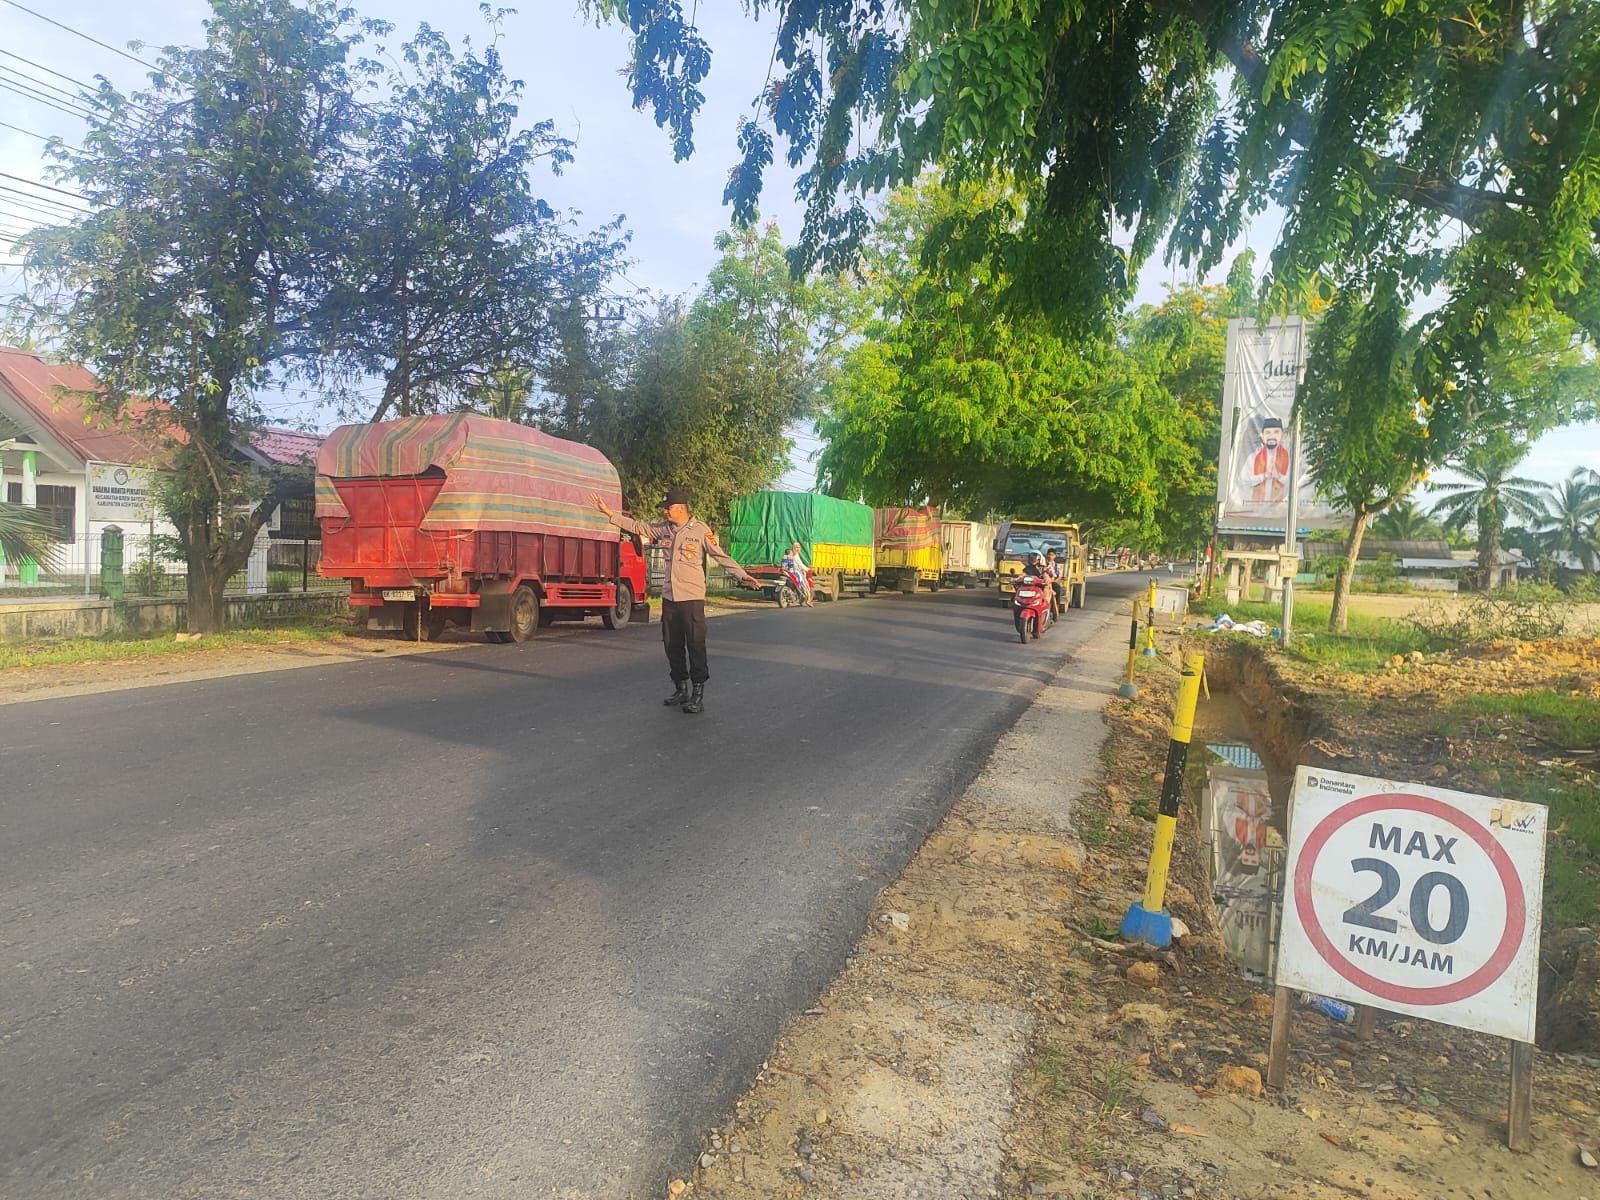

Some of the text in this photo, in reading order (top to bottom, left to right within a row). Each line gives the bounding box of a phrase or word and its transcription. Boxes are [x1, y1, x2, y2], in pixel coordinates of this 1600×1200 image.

[1319, 784, 1353, 795] Indonesia
[1320, 777, 1356, 789] Danantara
[1369, 823, 1459, 865] MAX
[1342, 857, 1470, 945] 20
[1348, 934, 1453, 974] KM/JAM
